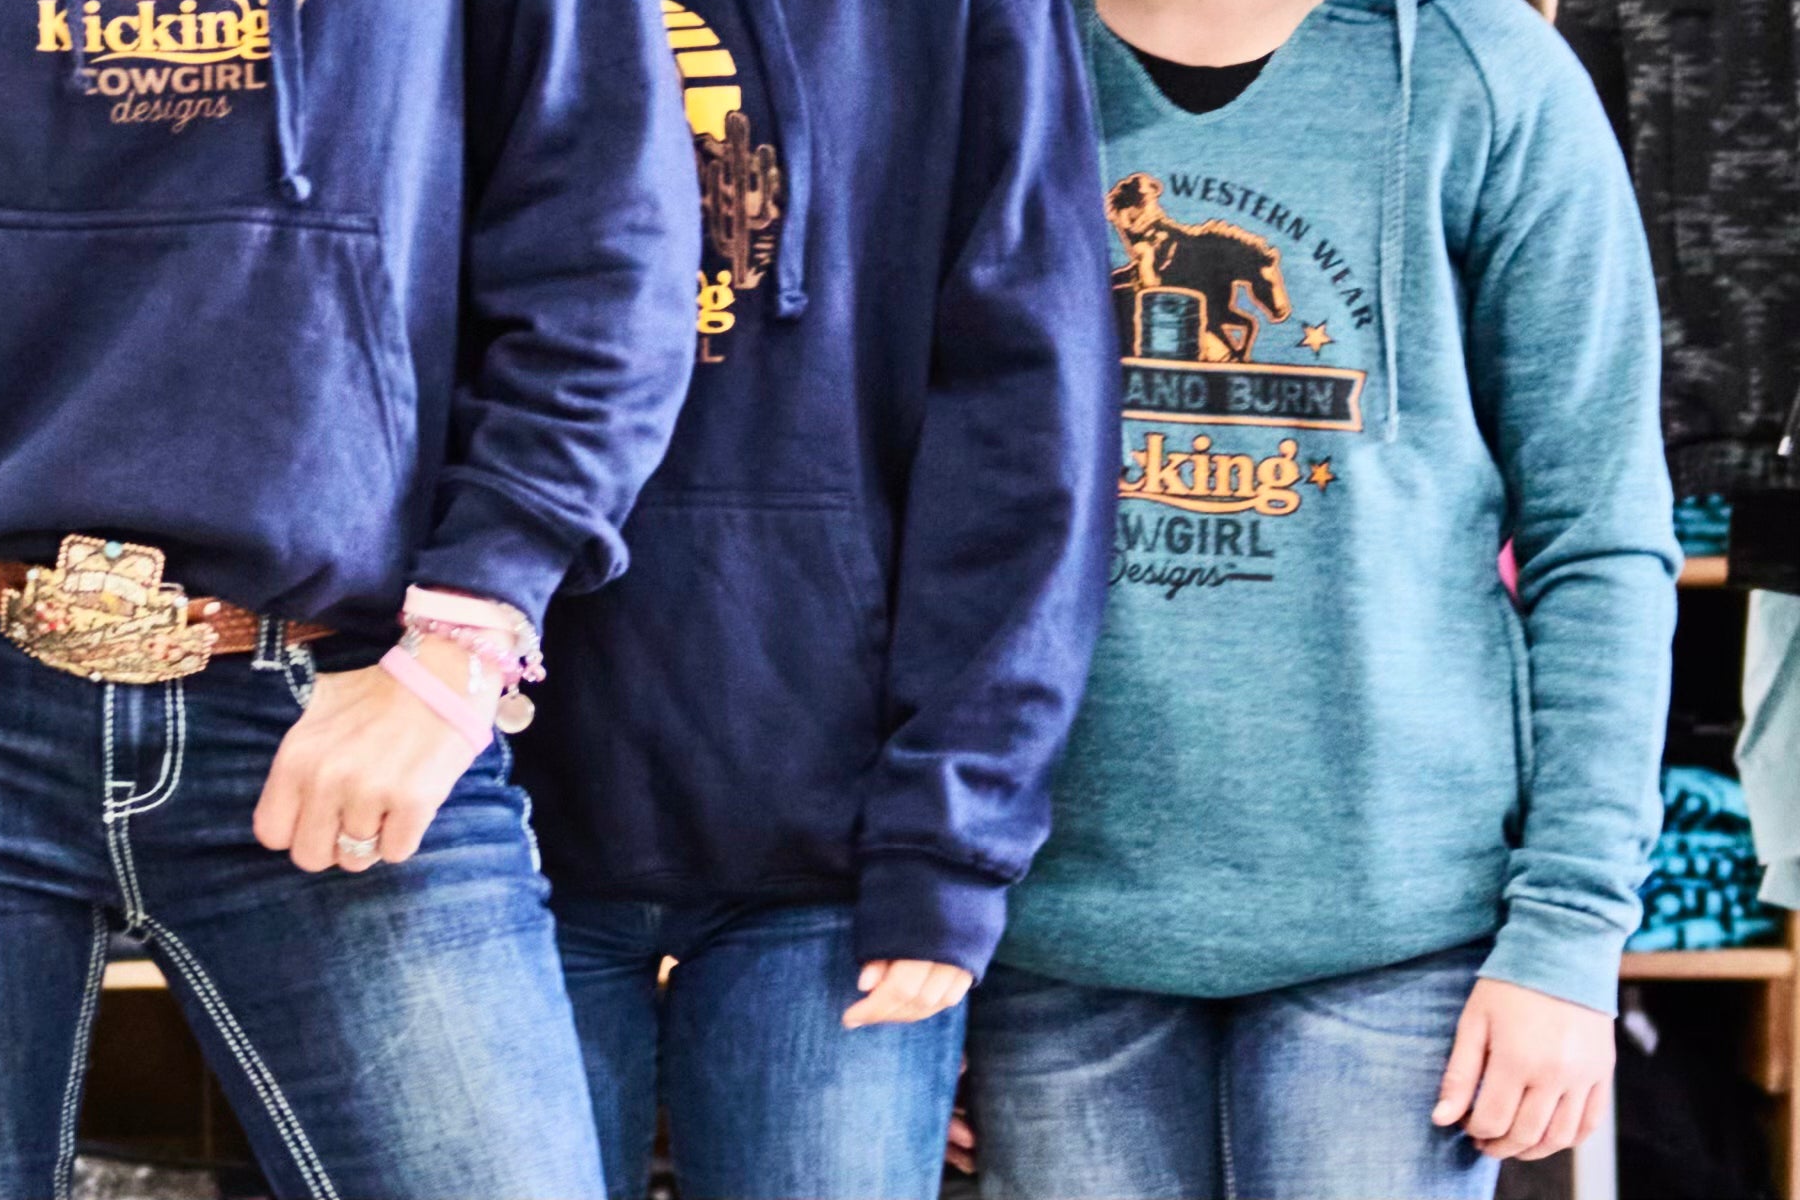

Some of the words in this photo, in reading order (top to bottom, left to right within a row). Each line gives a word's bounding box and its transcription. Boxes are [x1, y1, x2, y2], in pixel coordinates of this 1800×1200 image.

[110, 92, 232, 135] designs
[1168, 172, 1310, 242] WESTERN
[1312, 238, 1374, 330] WEAR
[1125, 370, 1207, 410] AND
[1231, 374, 1335, 416] BURN
[1118, 431, 1301, 515] cking
[1118, 513, 1275, 559] WGIRL
